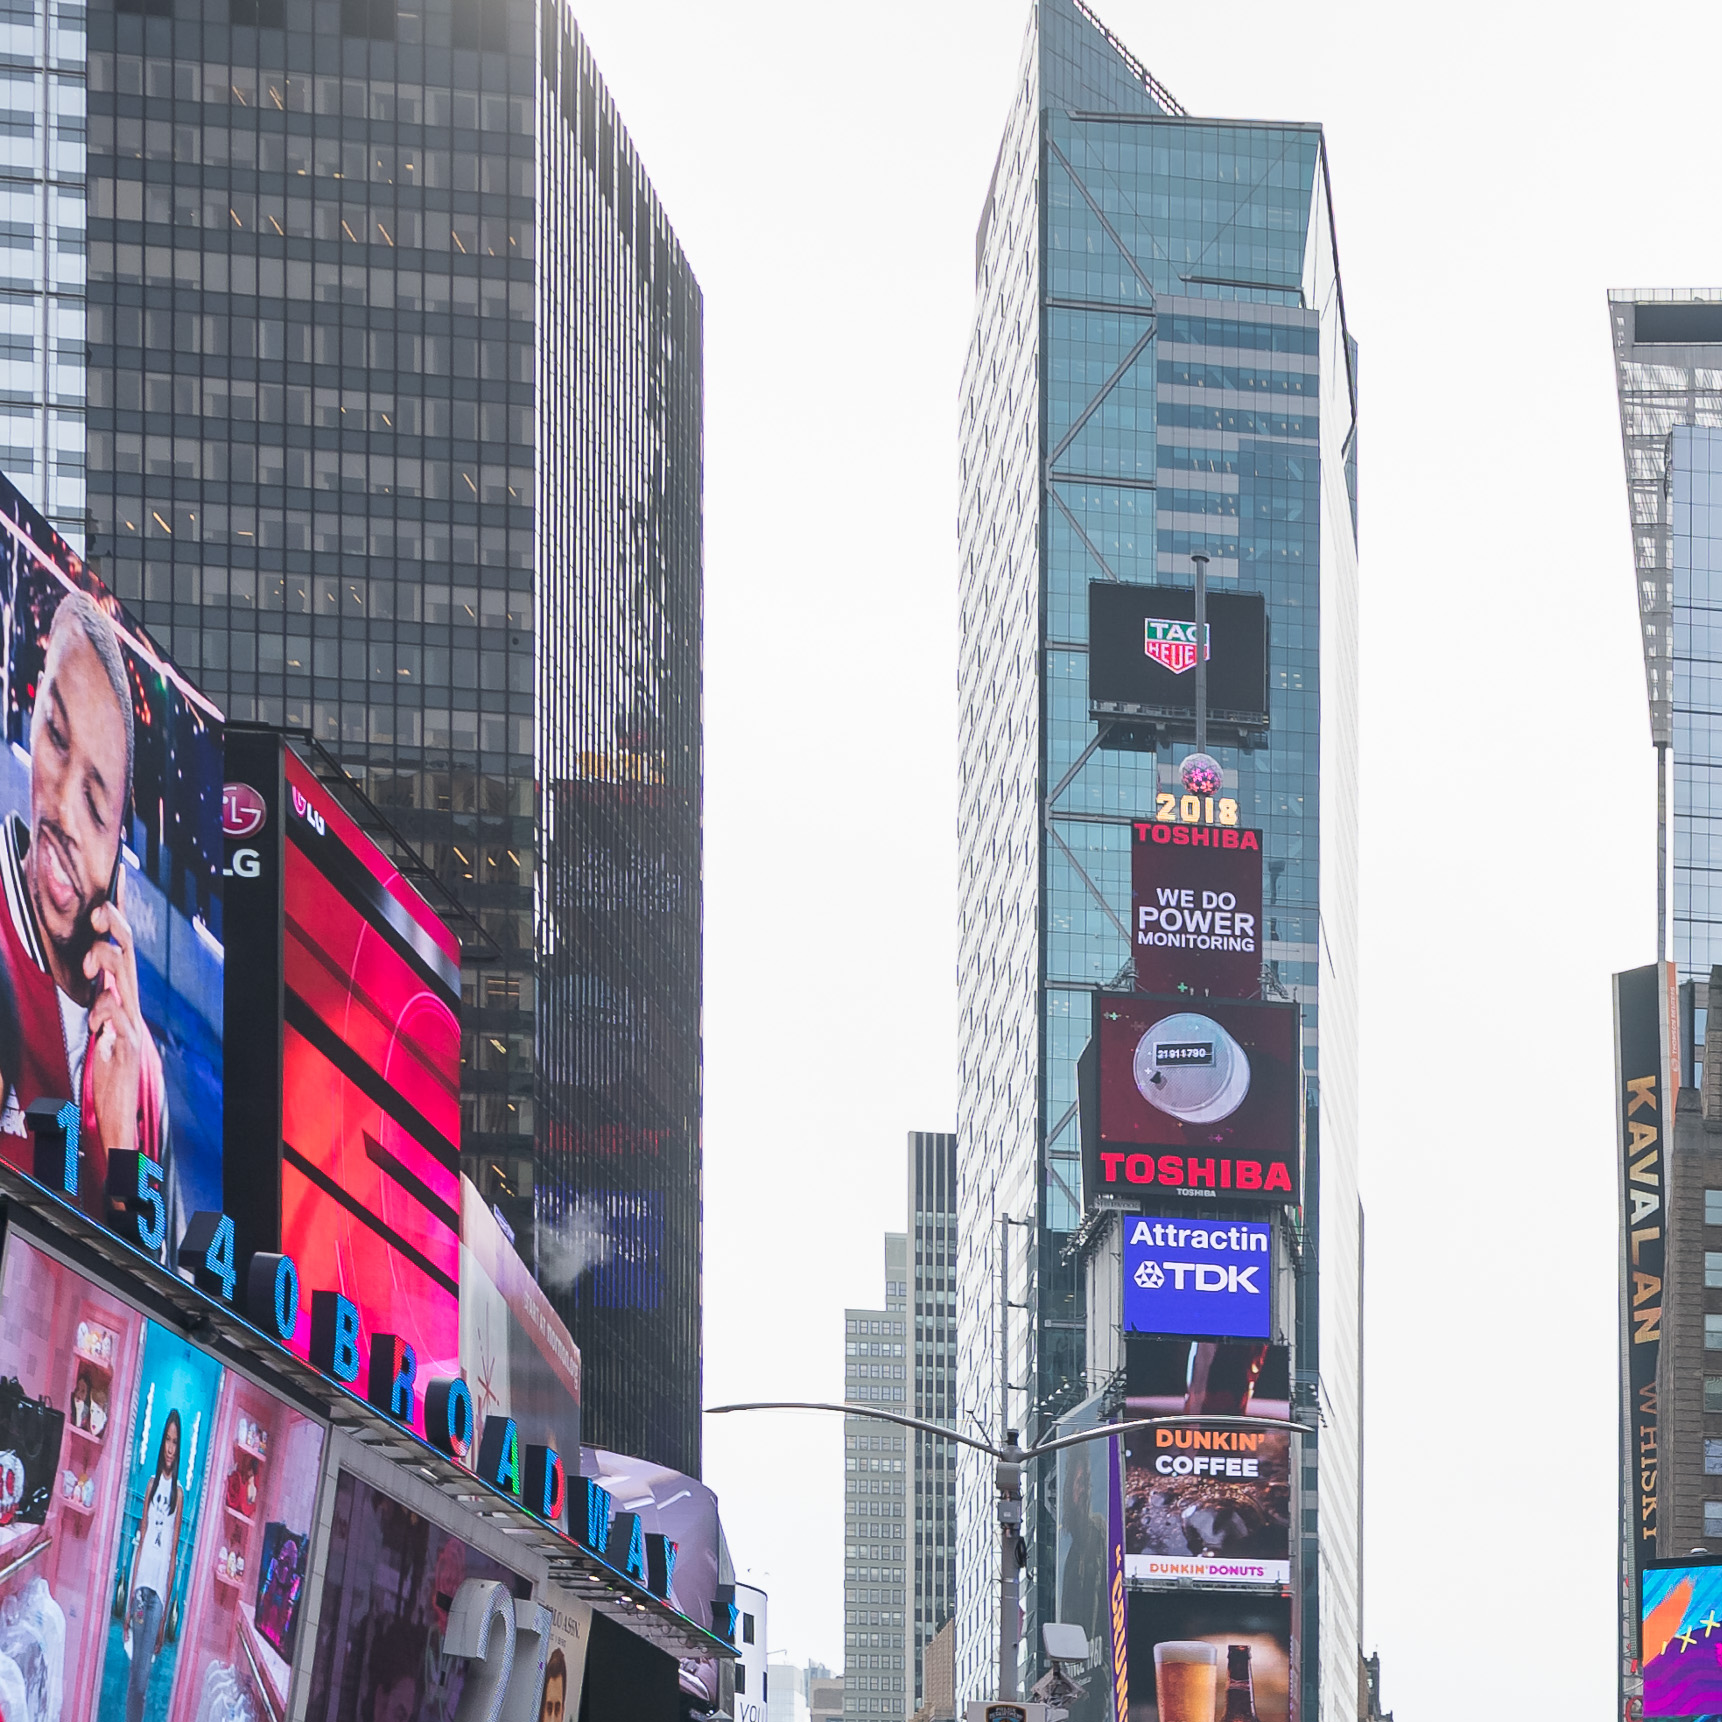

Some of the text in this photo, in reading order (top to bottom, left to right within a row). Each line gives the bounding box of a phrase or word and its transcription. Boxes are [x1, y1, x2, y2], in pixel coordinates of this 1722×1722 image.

[306, 809, 325, 836] LG
[1155, 792, 1238, 826] 2018
[1133, 822, 1260, 850] TOSHIBA
[1156, 887, 1236, 910] WE DO
[1138, 905, 1255, 938] POWER
[1137, 932, 1255, 952] MONITORING
[1100, 1152, 1292, 1192] TOSHIBA
[1176, 1188, 1217, 1197] TOSHIBA
[1627, 1075, 1661, 1345] KAVALAN
[1129, 1221, 1268, 1252] Attractin
[1162, 1261, 1260, 1294] TDK
[334, 1292, 679, 1601] BROADWAY
[1155, 1428, 1266, 1451] DUNKIN'
[1155, 1455, 1259, 1477] COFFEE
[1639, 1380, 1658, 1541] WHISKY
